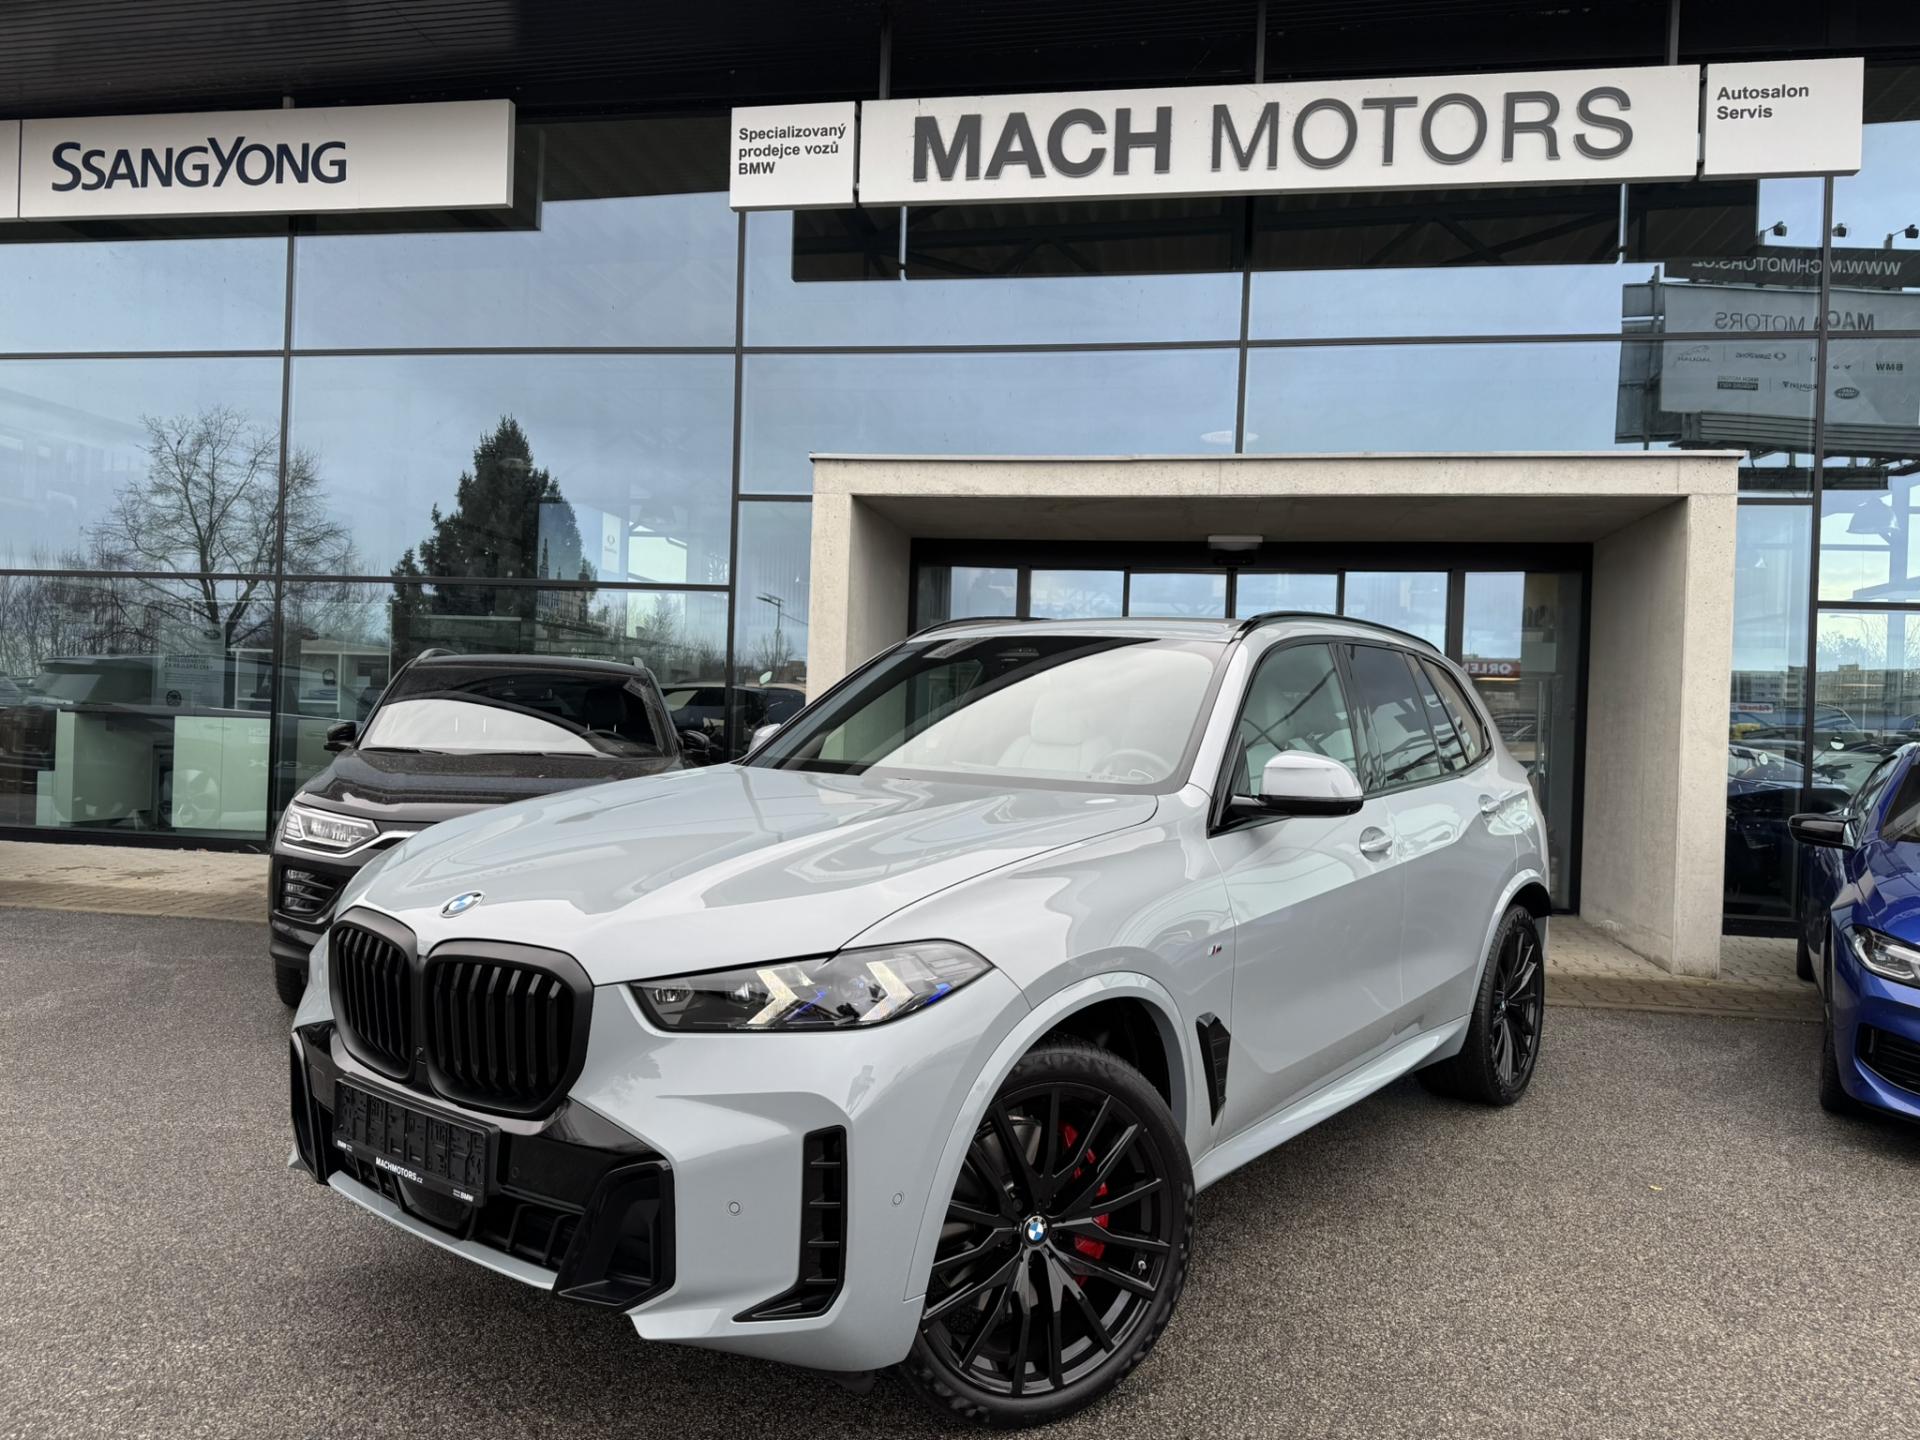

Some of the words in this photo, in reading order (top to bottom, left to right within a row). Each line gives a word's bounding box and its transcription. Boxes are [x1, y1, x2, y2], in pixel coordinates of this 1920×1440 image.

[1717, 84, 1810, 101] Autosalon
[1716, 104, 1773, 120] Servis
[738, 122, 847, 143] Specializovaný
[912, 105, 1173, 182] MACH
[1210, 85, 1634, 173] MOTORS
[738, 143, 801, 161] prodejce
[804, 141, 839, 155] vozů
[738, 161, 776, 175] BMW
